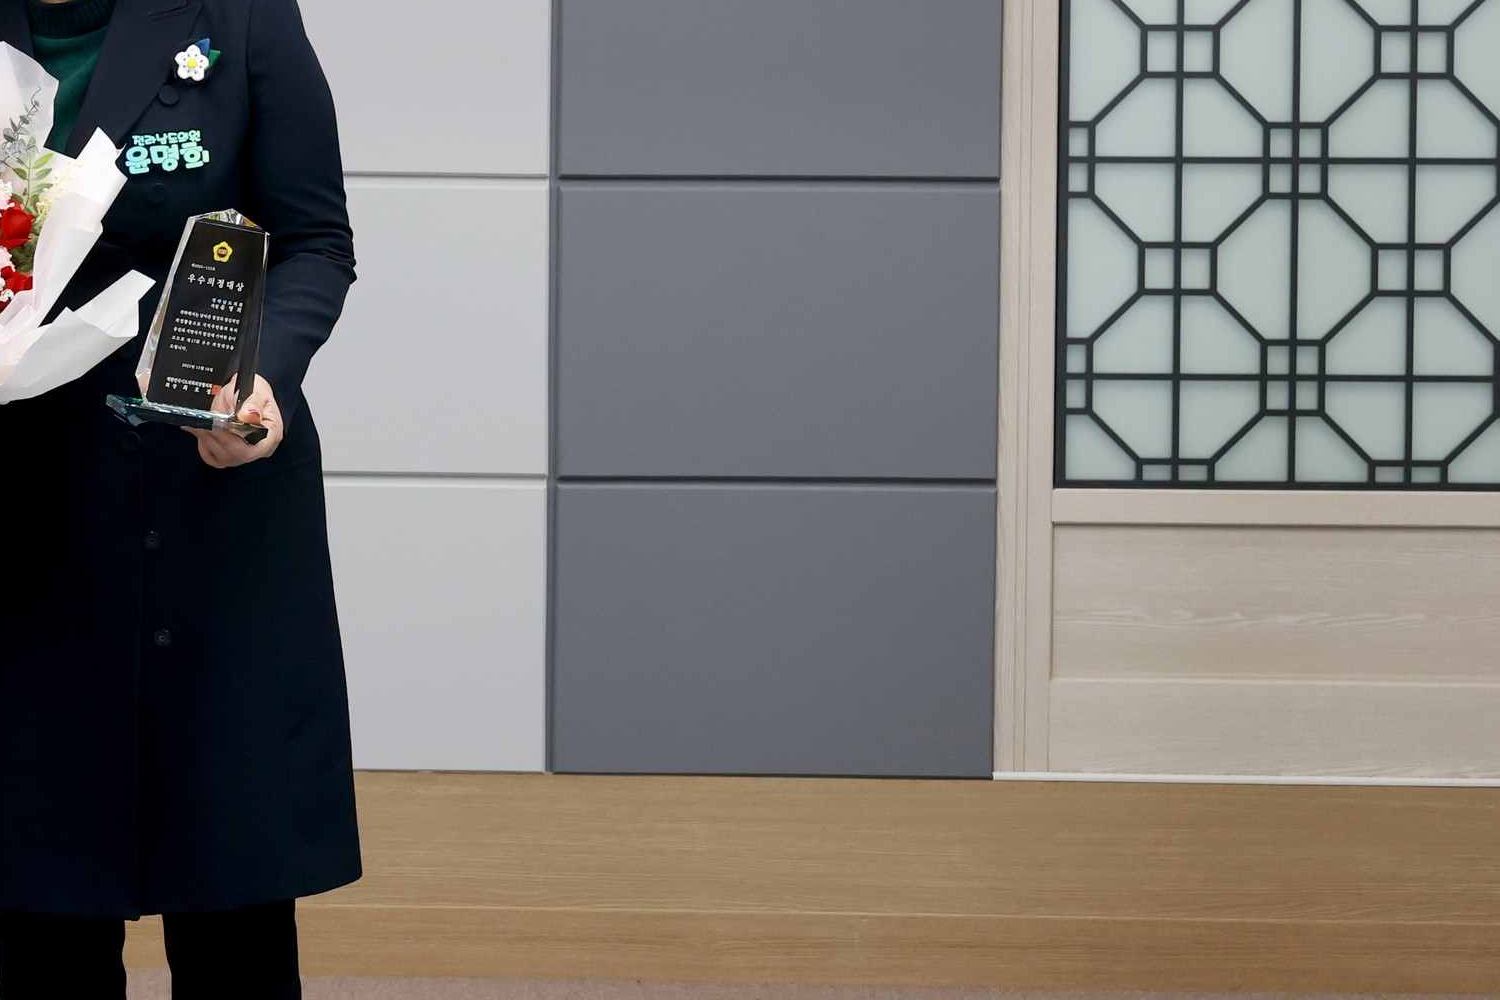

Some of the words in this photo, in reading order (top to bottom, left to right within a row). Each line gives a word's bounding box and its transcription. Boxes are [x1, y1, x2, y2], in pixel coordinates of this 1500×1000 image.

[131, 129, 202, 147] 전라남도의원
[125, 141, 210, 175] 윤명희
[187, 273, 245, 292] 우수의정대상
